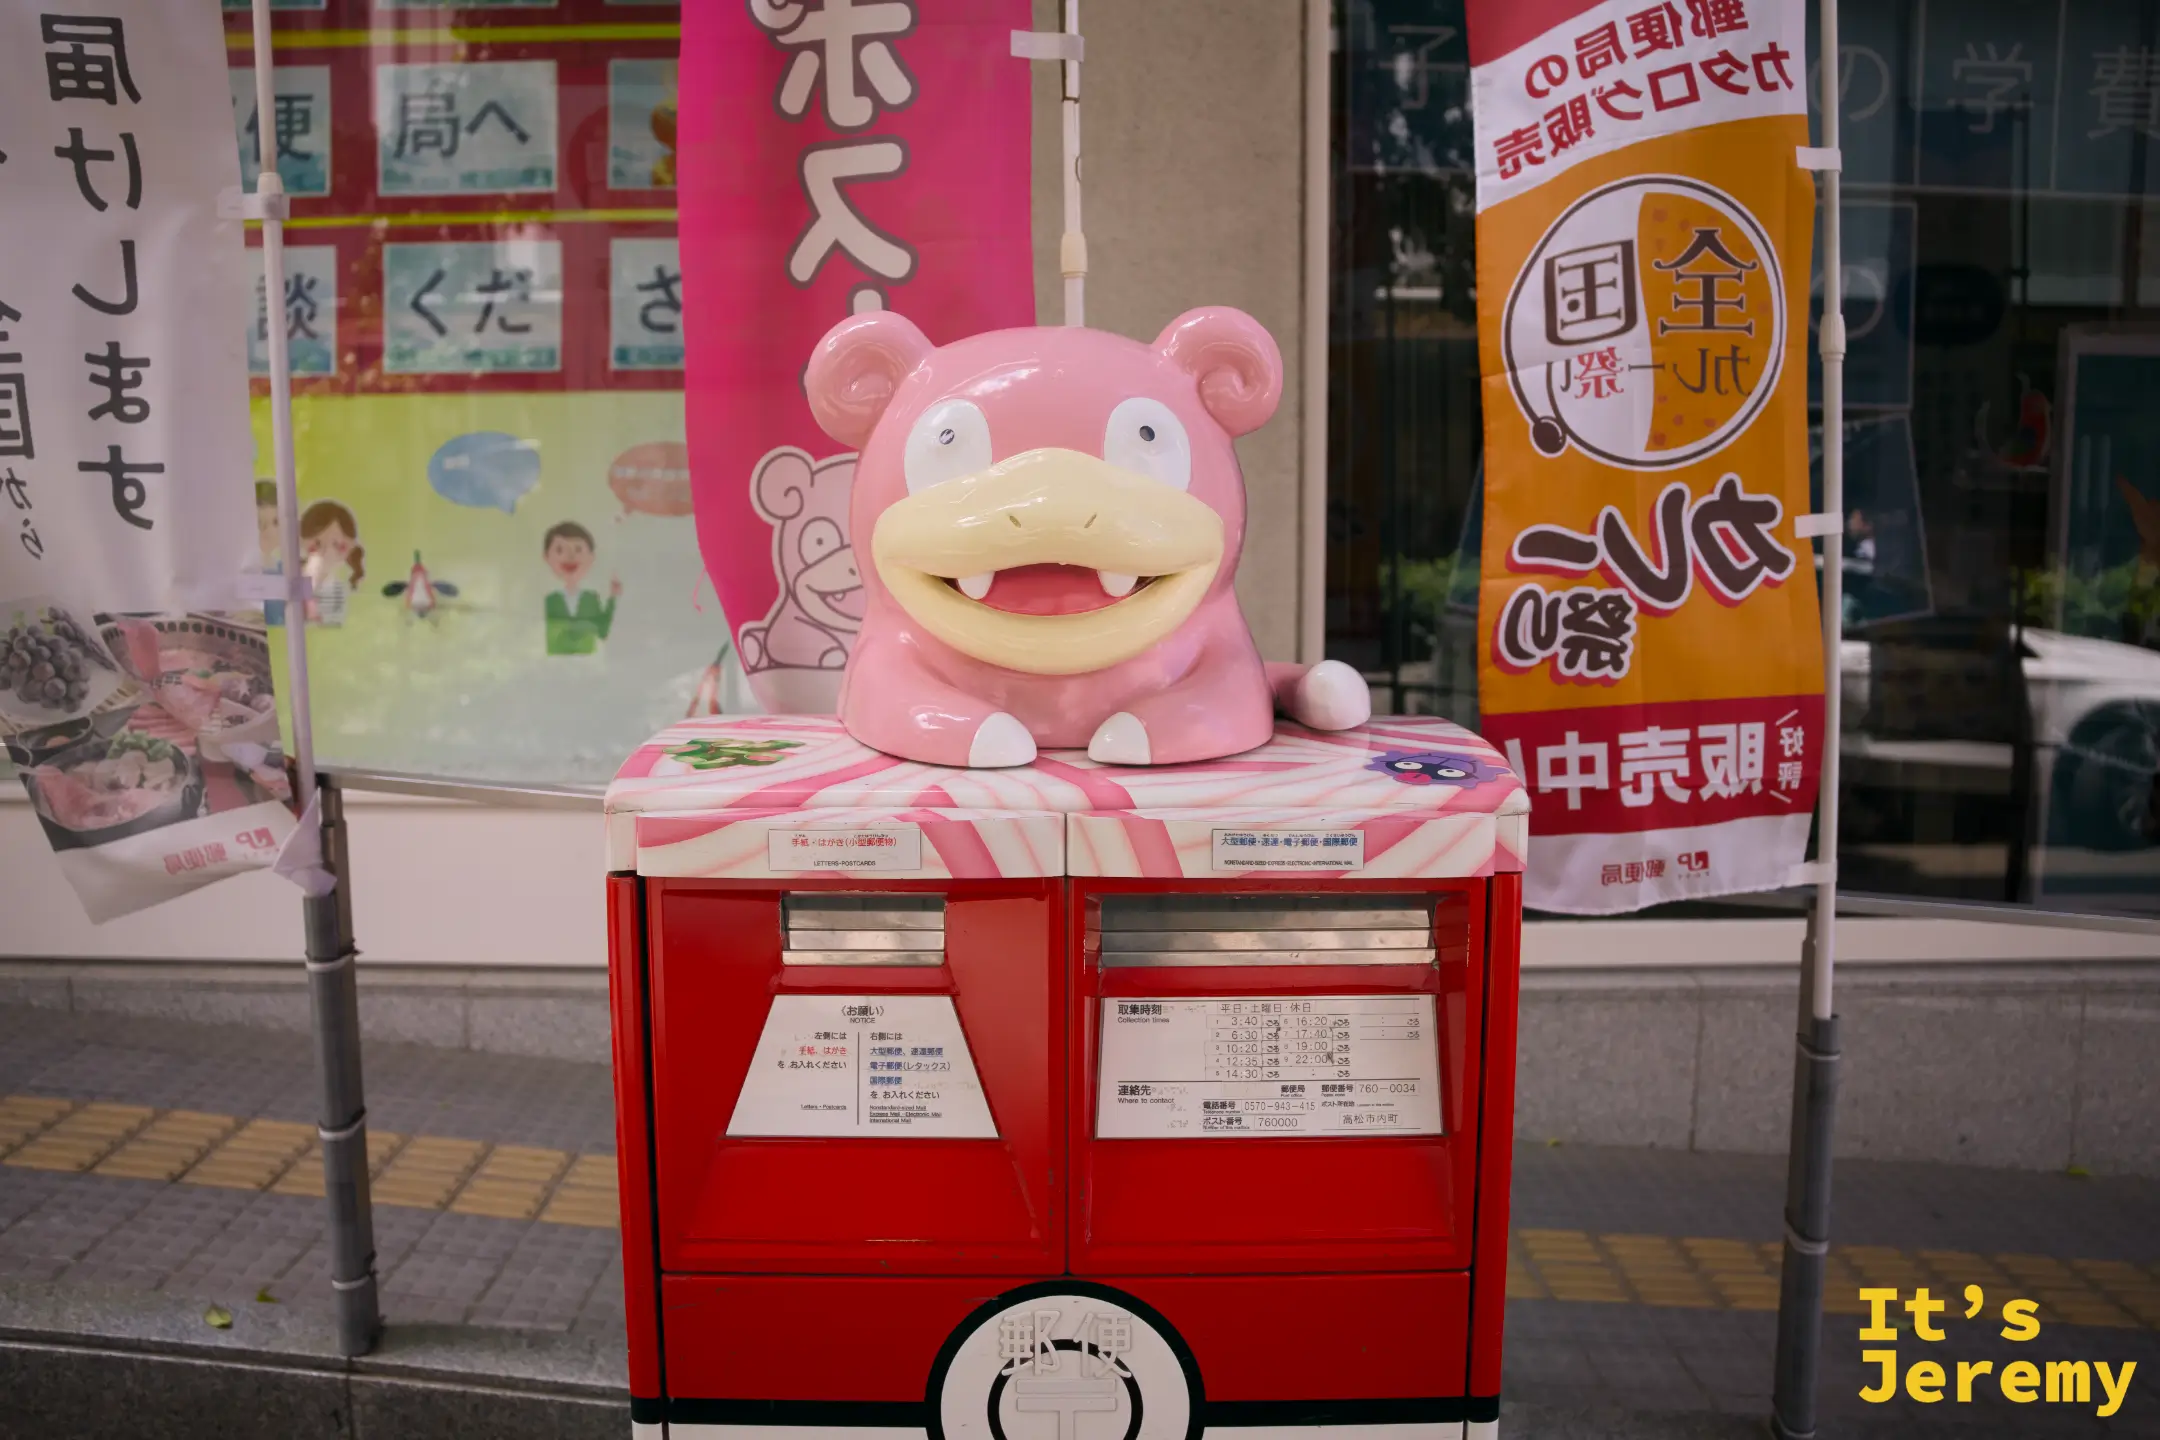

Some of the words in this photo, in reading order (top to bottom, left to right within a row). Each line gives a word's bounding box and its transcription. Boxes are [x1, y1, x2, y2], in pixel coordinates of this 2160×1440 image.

[1117, 1004, 1162, 1015] 取集時刻
[1231, 1016, 1258, 1026] 3:40
[1296, 1016, 1328, 1026] 16:20
[814, 1031, 847, 1041] 左側には
[869, 1031, 903, 1041] 右側には
[1231, 1030, 1258, 1040] 6:30
[1296, 1029, 1328, 1038] 17:40
[1226, 1043, 1258, 1053] 10:20
[1296, 1041, 1328, 1051] 19:00
[1226, 1056, 1258, 1066] 12:35
[1295, 1054, 1328, 1064] 22:00
[1226, 1069, 1258, 1078] 14:30
[1117, 1085, 1151, 1095] 連絡先
[1258, 1117, 1298, 1127] 760000
[1000, 1309, 1133, 1378] 郵便
